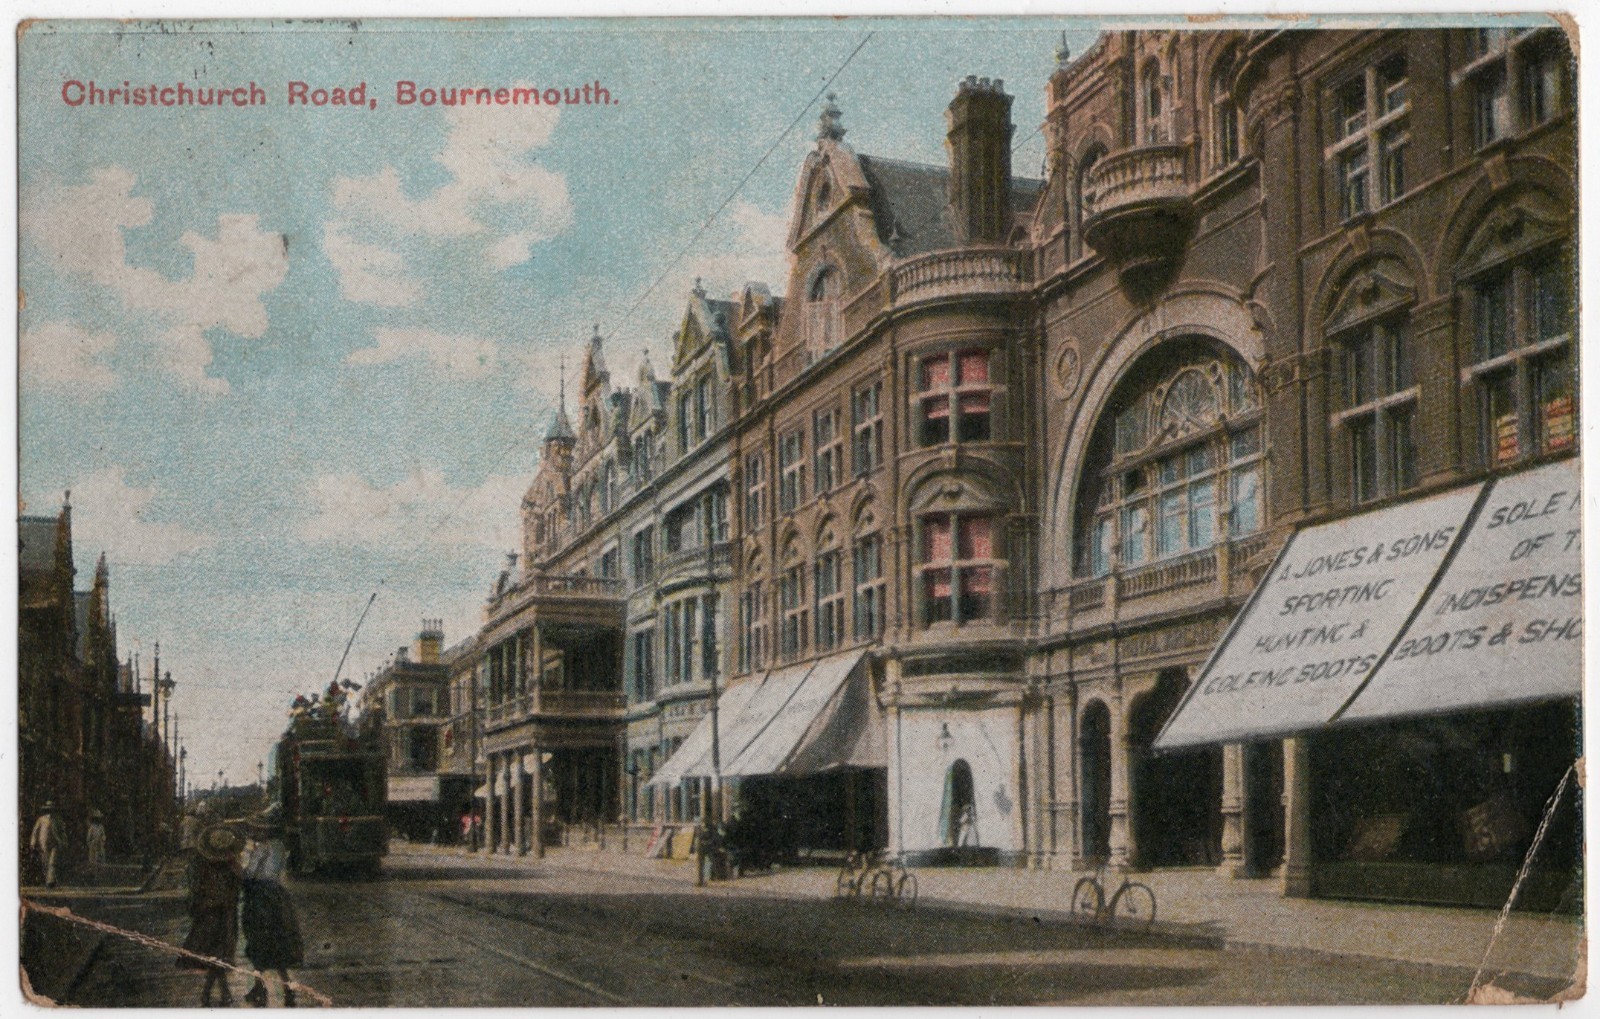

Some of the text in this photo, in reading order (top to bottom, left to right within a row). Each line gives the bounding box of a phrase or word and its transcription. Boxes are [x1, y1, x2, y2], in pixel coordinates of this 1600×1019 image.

[1487, 491, 1567, 529] SOLE
[1386, 526, 1455, 561] SONS
[1510, 532, 1555, 562] OF
[1394, 625, 1488, 662] BOOTS
[1487, 622, 1514, 646] &
